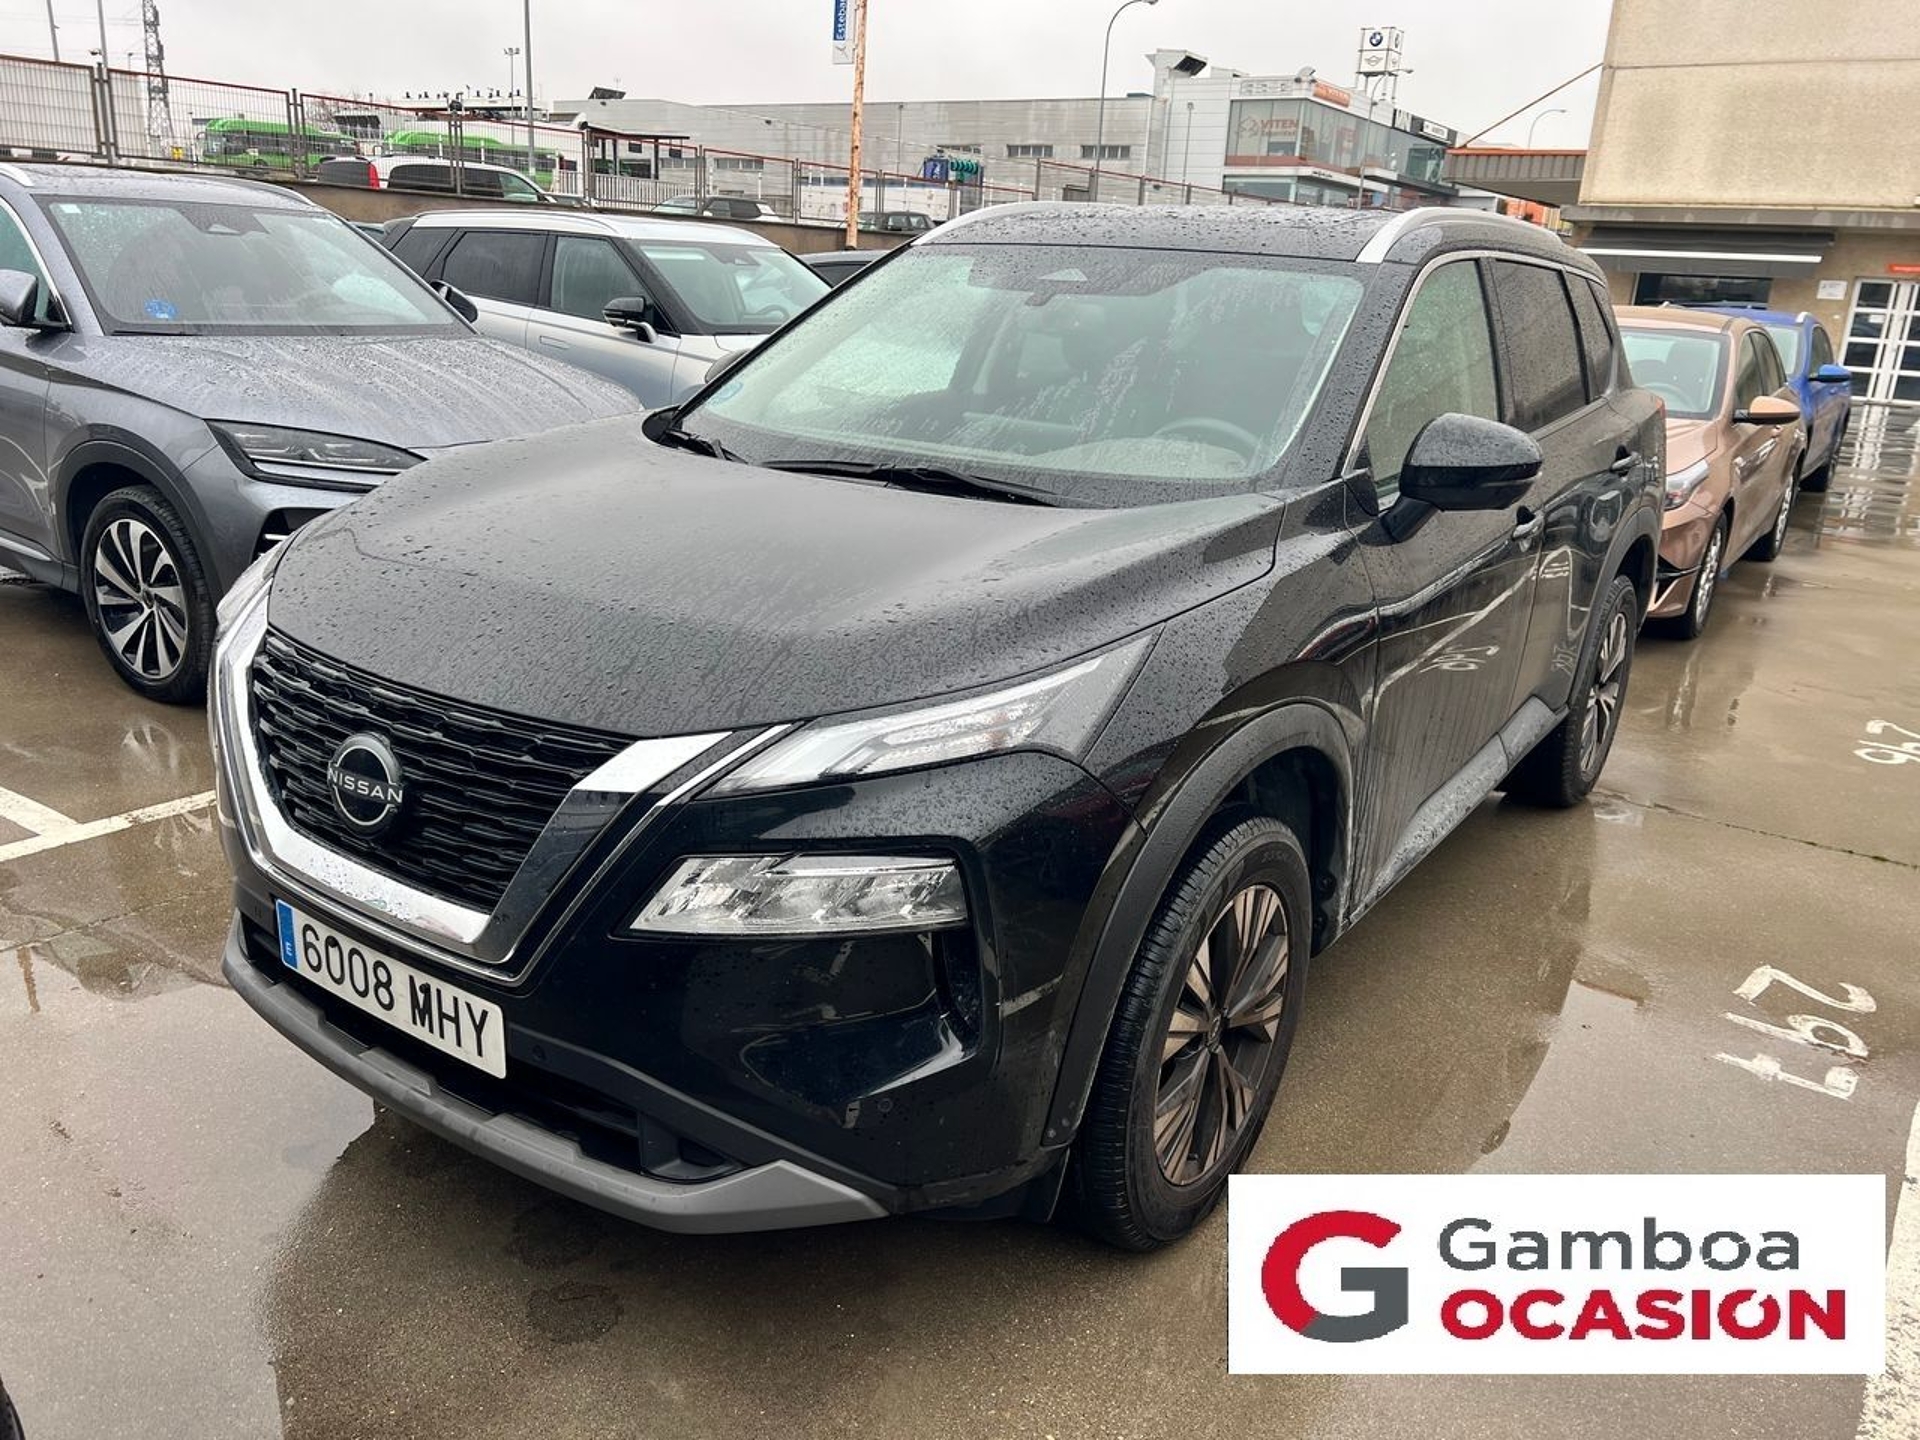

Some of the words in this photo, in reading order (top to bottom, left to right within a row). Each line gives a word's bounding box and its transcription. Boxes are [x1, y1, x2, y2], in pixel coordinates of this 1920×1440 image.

[836, 0, 846, 39] Esteba
[327, 767, 403, 803] NISSAN
[302, 923, 395, 1011] 6008
[408, 974, 489, 1058] MHY
